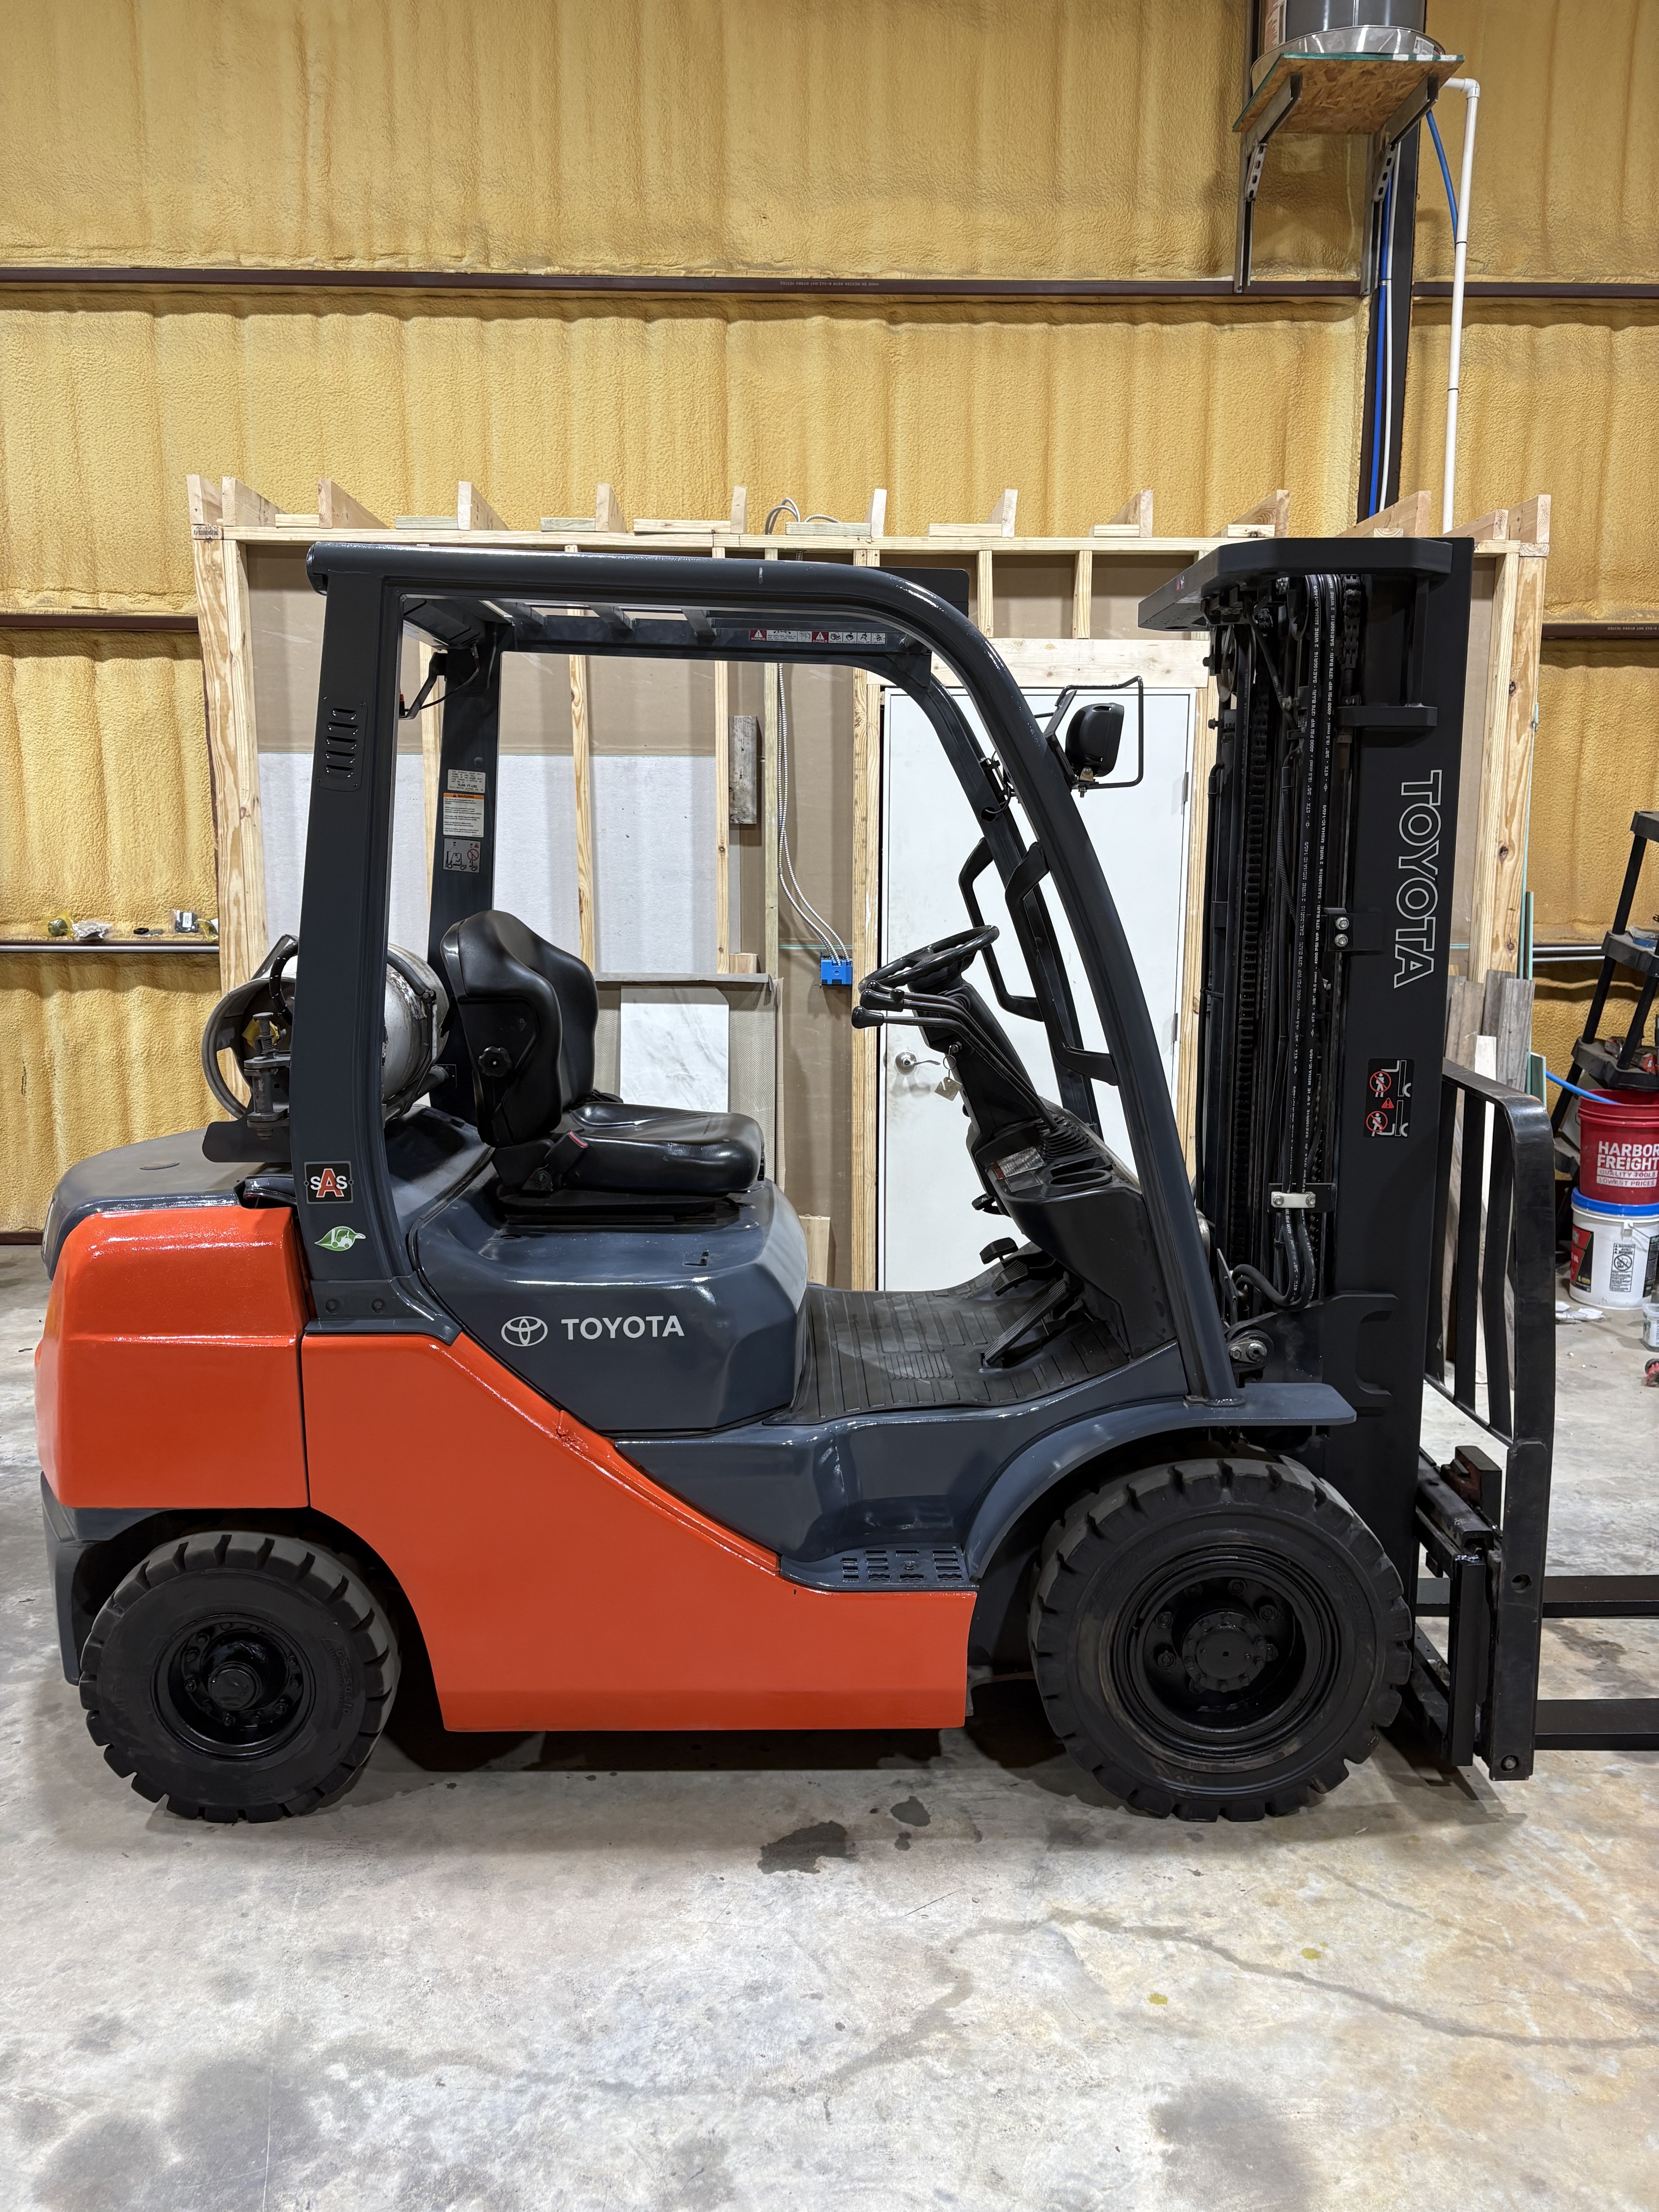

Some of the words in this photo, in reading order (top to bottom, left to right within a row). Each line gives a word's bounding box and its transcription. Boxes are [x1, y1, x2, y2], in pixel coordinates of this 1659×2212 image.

[1329, 682, 1333, 690] WP
[1311, 719, 1315, 728] WP
[1394, 769, 1442, 989] TOYOTA
[1316, 933, 1320, 941] WP
[1598, 1141, 1659, 1157] HARBOR
[1597, 1154, 1659, 1170] FREIGHT
[310, 1168, 348, 1198] SAS
[1599, 1178, 1628, 1186] LOWEST
[561, 1315, 685, 1340] TOYOTA
